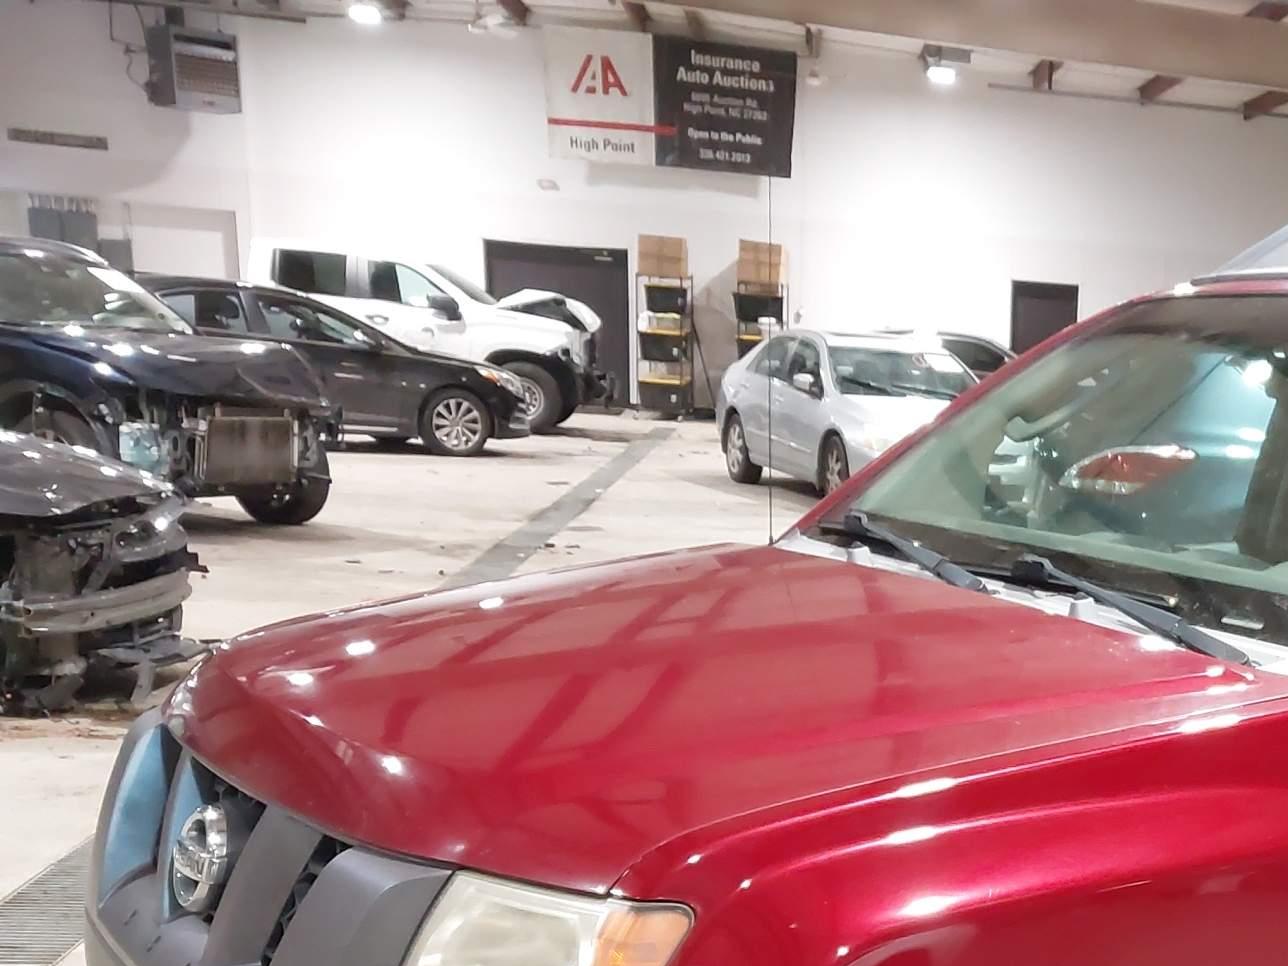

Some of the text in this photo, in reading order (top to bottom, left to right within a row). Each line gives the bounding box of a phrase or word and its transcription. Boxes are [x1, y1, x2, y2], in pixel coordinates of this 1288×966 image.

[691, 50, 760, 73] Insurance
[676, 66, 709, 84] Auto
[688, 127, 709, 140] Open
[711, 131, 719, 141] to
[720, 131, 734, 142] the
[570, 136, 636, 153] High Point
